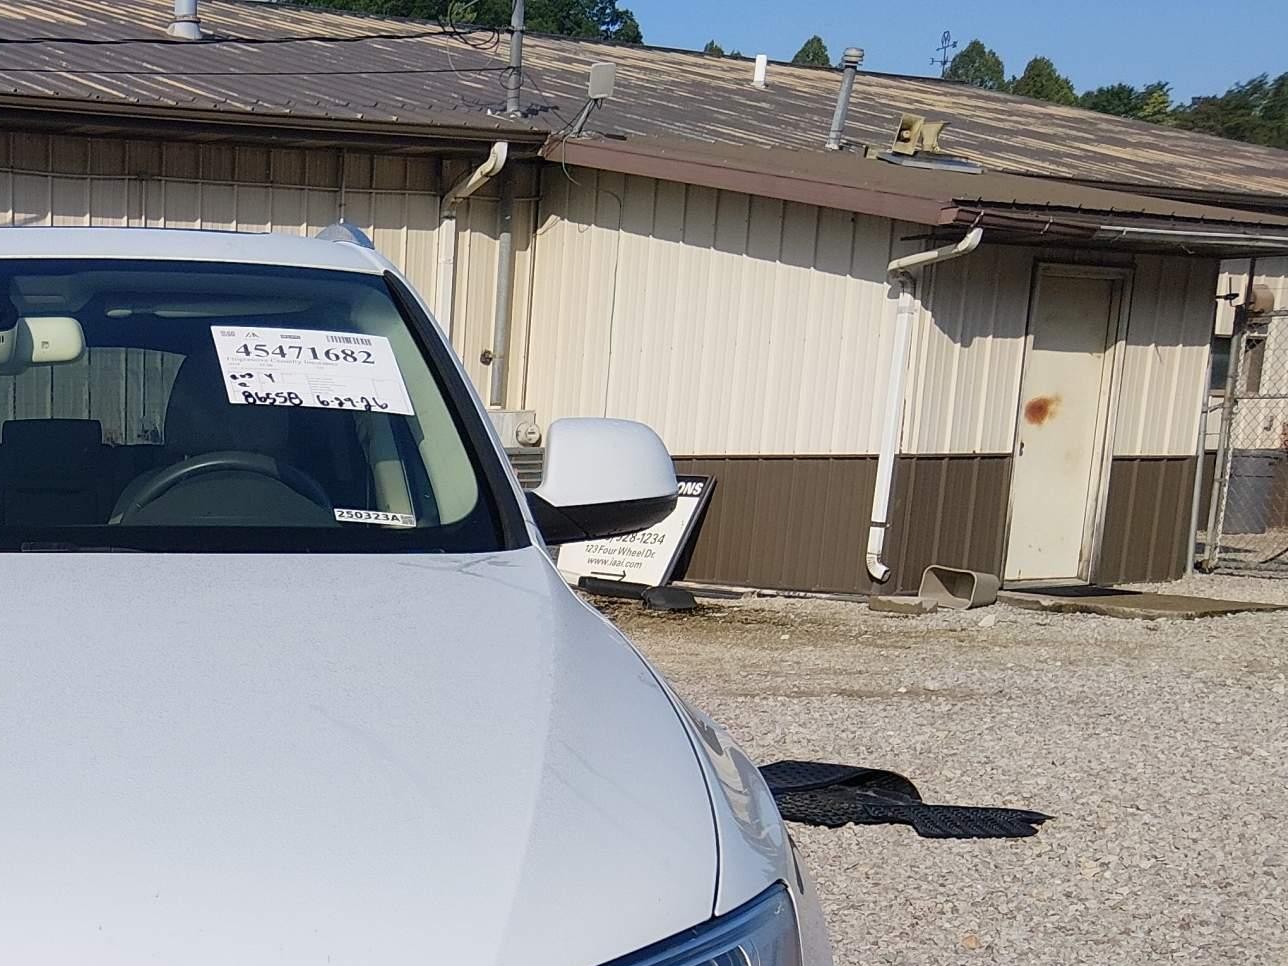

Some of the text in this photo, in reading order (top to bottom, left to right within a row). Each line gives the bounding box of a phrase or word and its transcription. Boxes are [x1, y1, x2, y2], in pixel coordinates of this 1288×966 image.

[235, 342, 376, 365] 45471682
[336, 510, 400, 522] 250323A
[584, 544, 599, 553] 123
[598, 545, 618, 555] Four
[618, 546, 645, 557] Wheel
[587, 557, 643, 569] www.iaai.com
